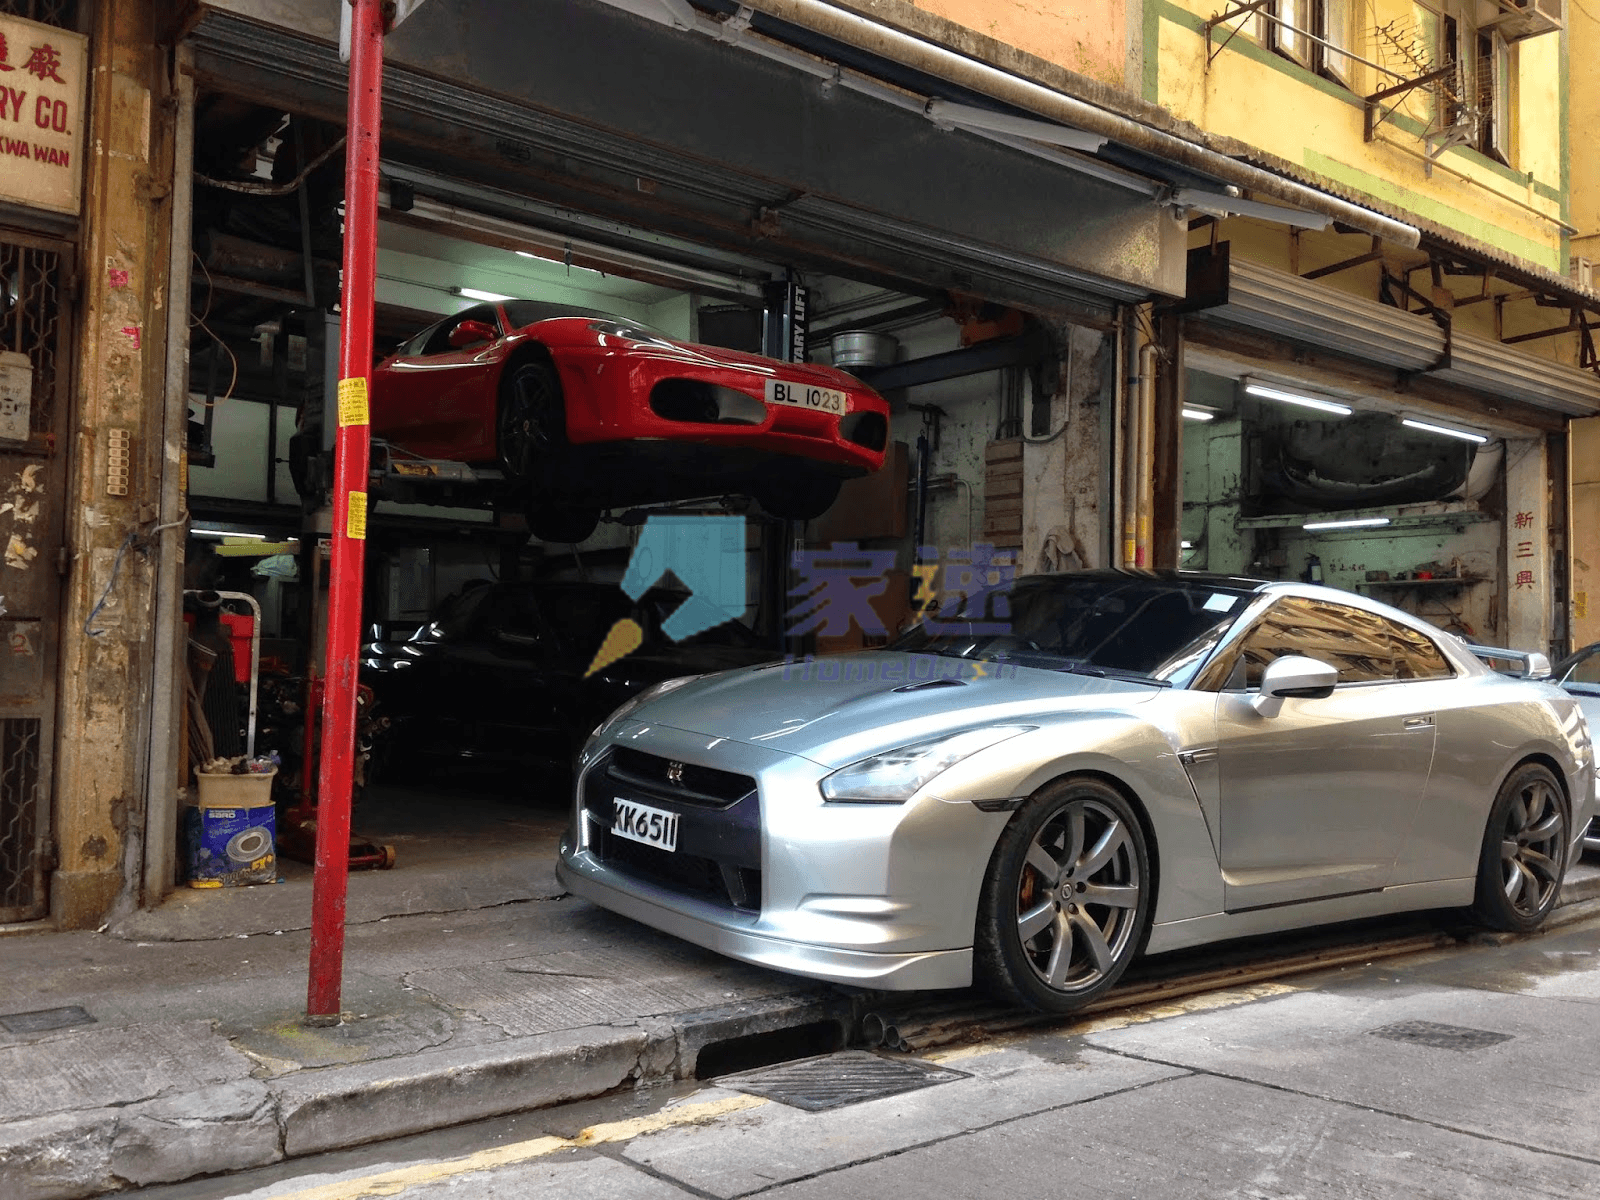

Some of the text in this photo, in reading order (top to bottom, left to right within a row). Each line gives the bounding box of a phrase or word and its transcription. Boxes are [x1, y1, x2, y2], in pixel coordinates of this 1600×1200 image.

[35, 95, 72, 136] CO.
[33, 143, 70, 168] WAN
[794, 285, 806, 321] LIFT
[774, 383, 840, 411] BL 1023
[1514, 511, 1536, 590] 新三興
